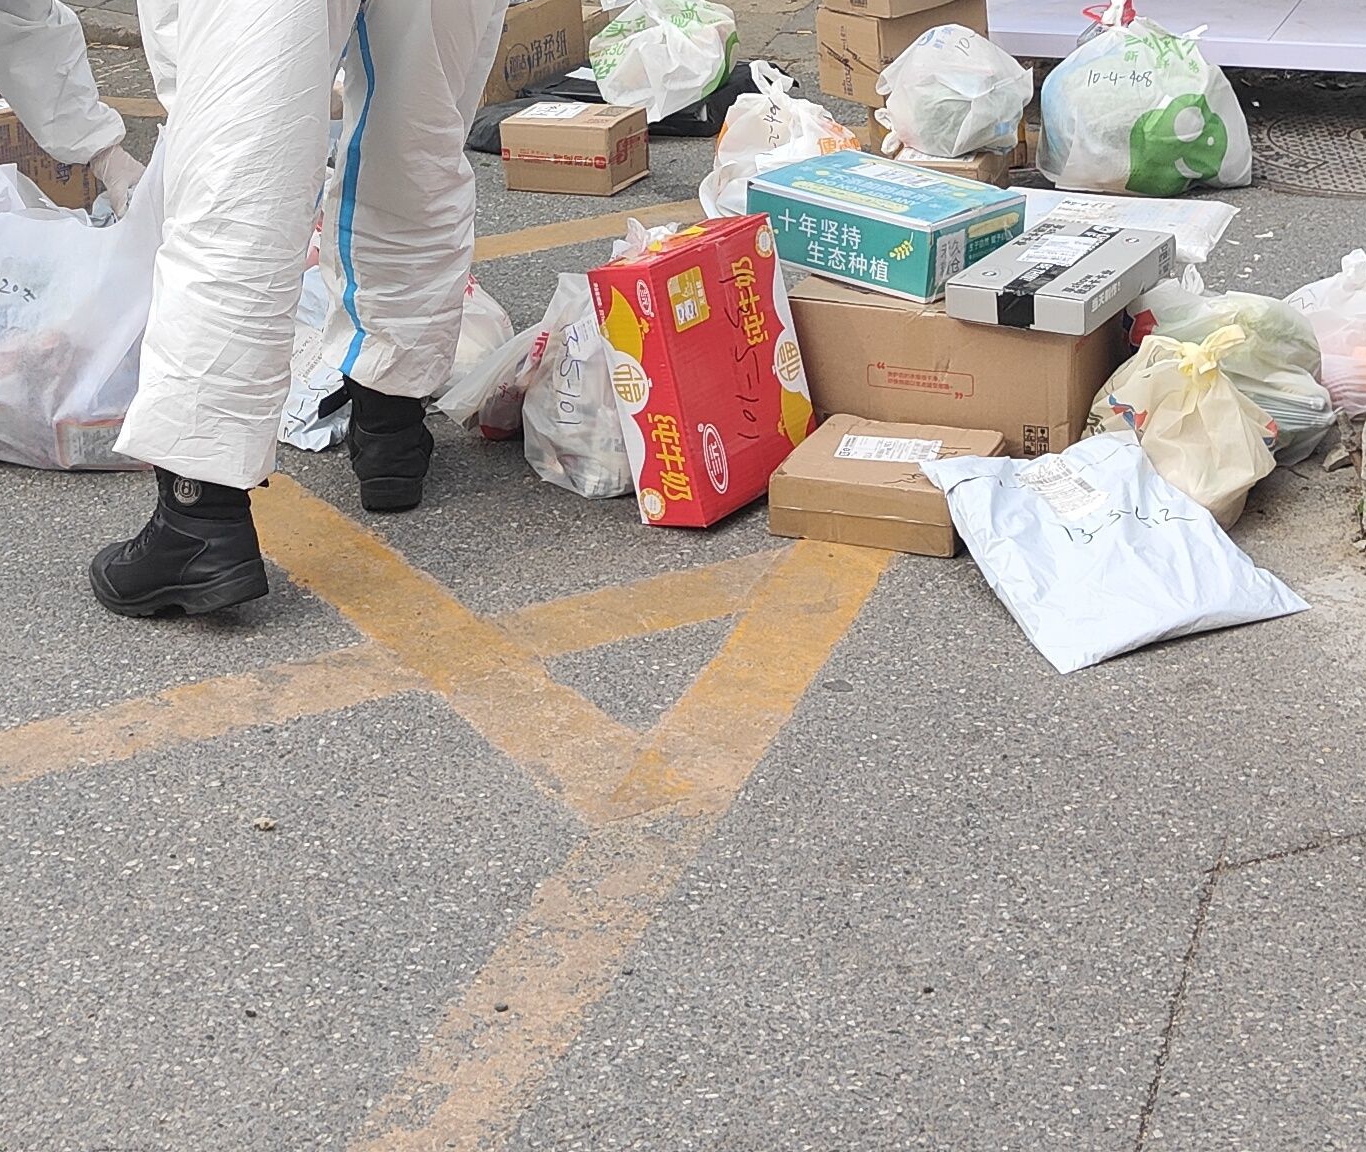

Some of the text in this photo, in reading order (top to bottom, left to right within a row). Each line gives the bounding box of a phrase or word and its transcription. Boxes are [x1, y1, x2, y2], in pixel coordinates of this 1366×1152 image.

[777, 208, 862, 249] 十年坚持
[806, 241, 890, 283] 生态种植
[647, 412, 694, 501] 纯牛奶
